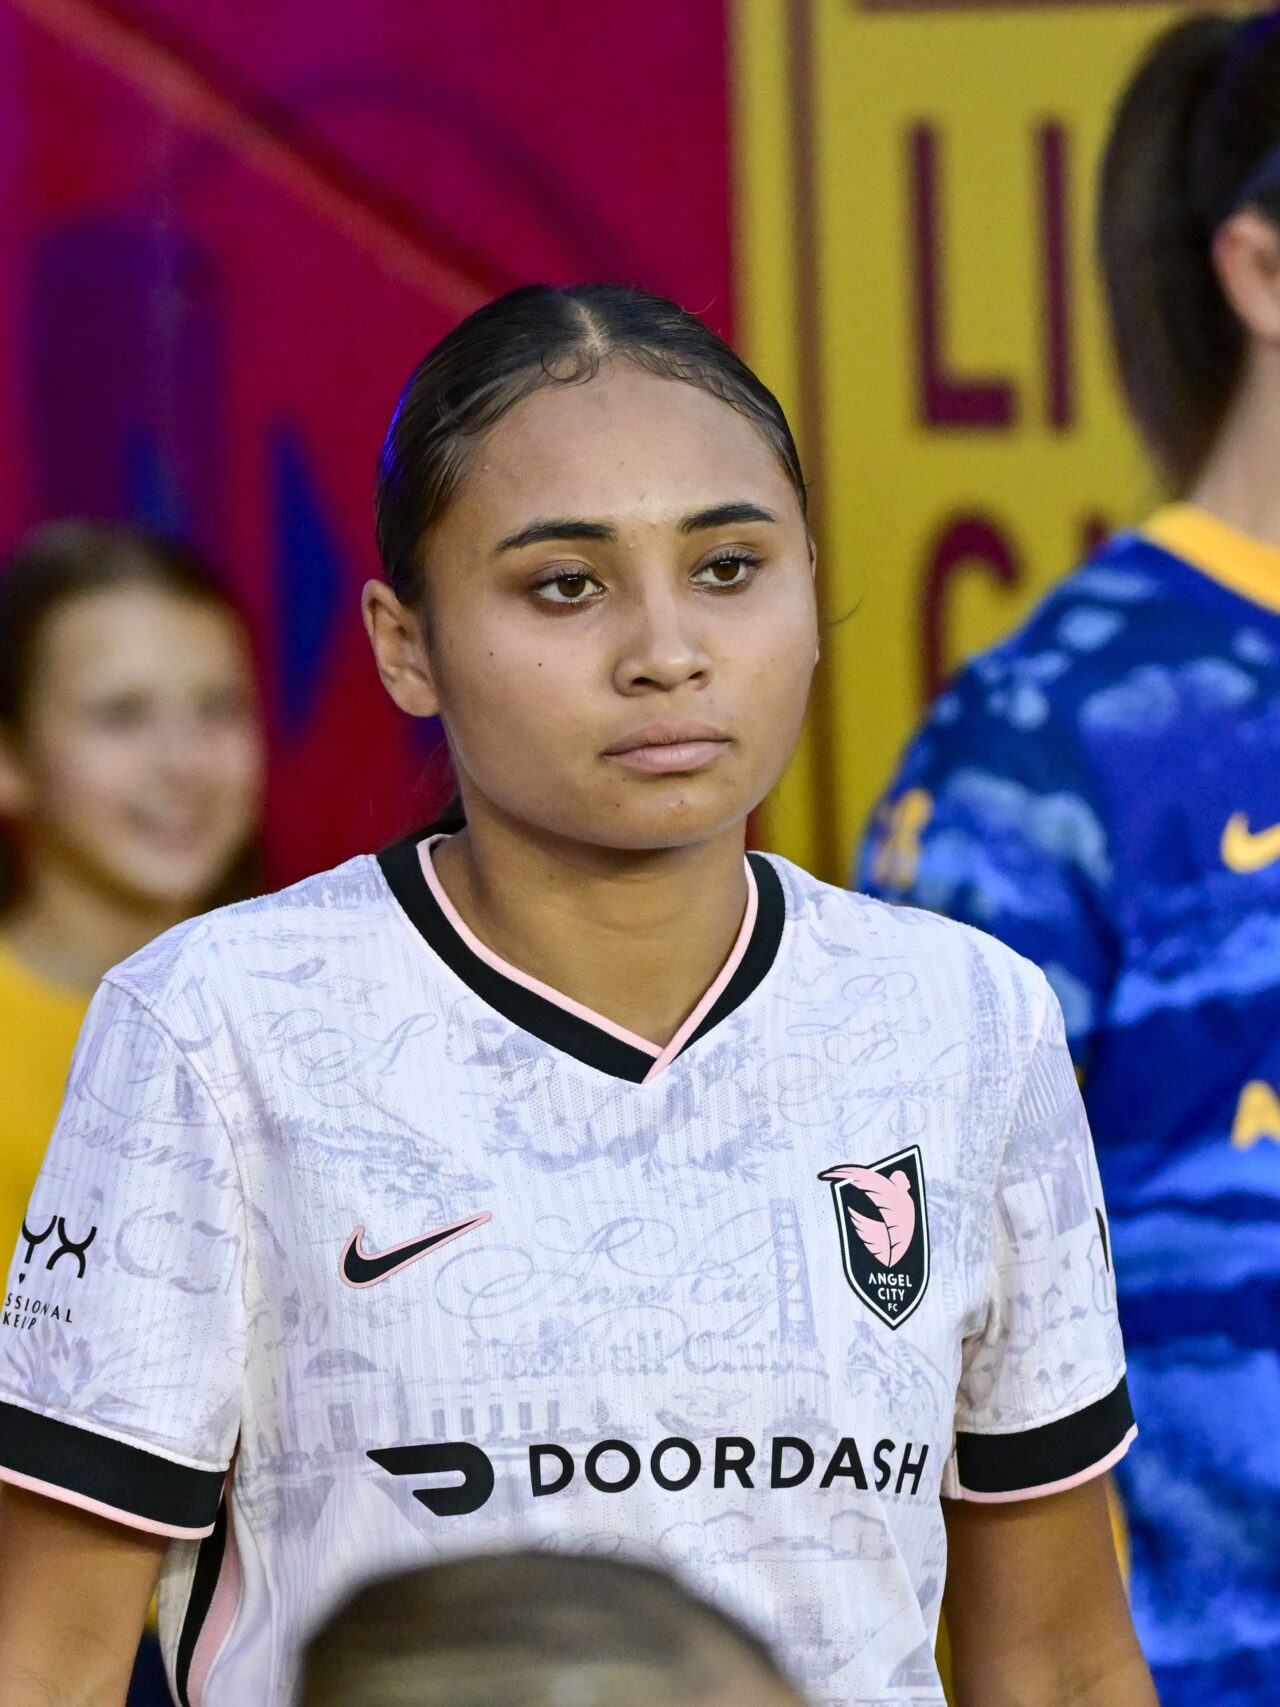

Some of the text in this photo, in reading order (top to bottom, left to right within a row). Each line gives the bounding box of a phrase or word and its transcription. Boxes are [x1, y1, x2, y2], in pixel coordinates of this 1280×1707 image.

[868, 1272, 913, 1287] ANGEL
[877, 1287, 906, 1302] CITY
[887, 1302, 899, 1312] FC
[528, 1436, 930, 1497] DOORDASH
